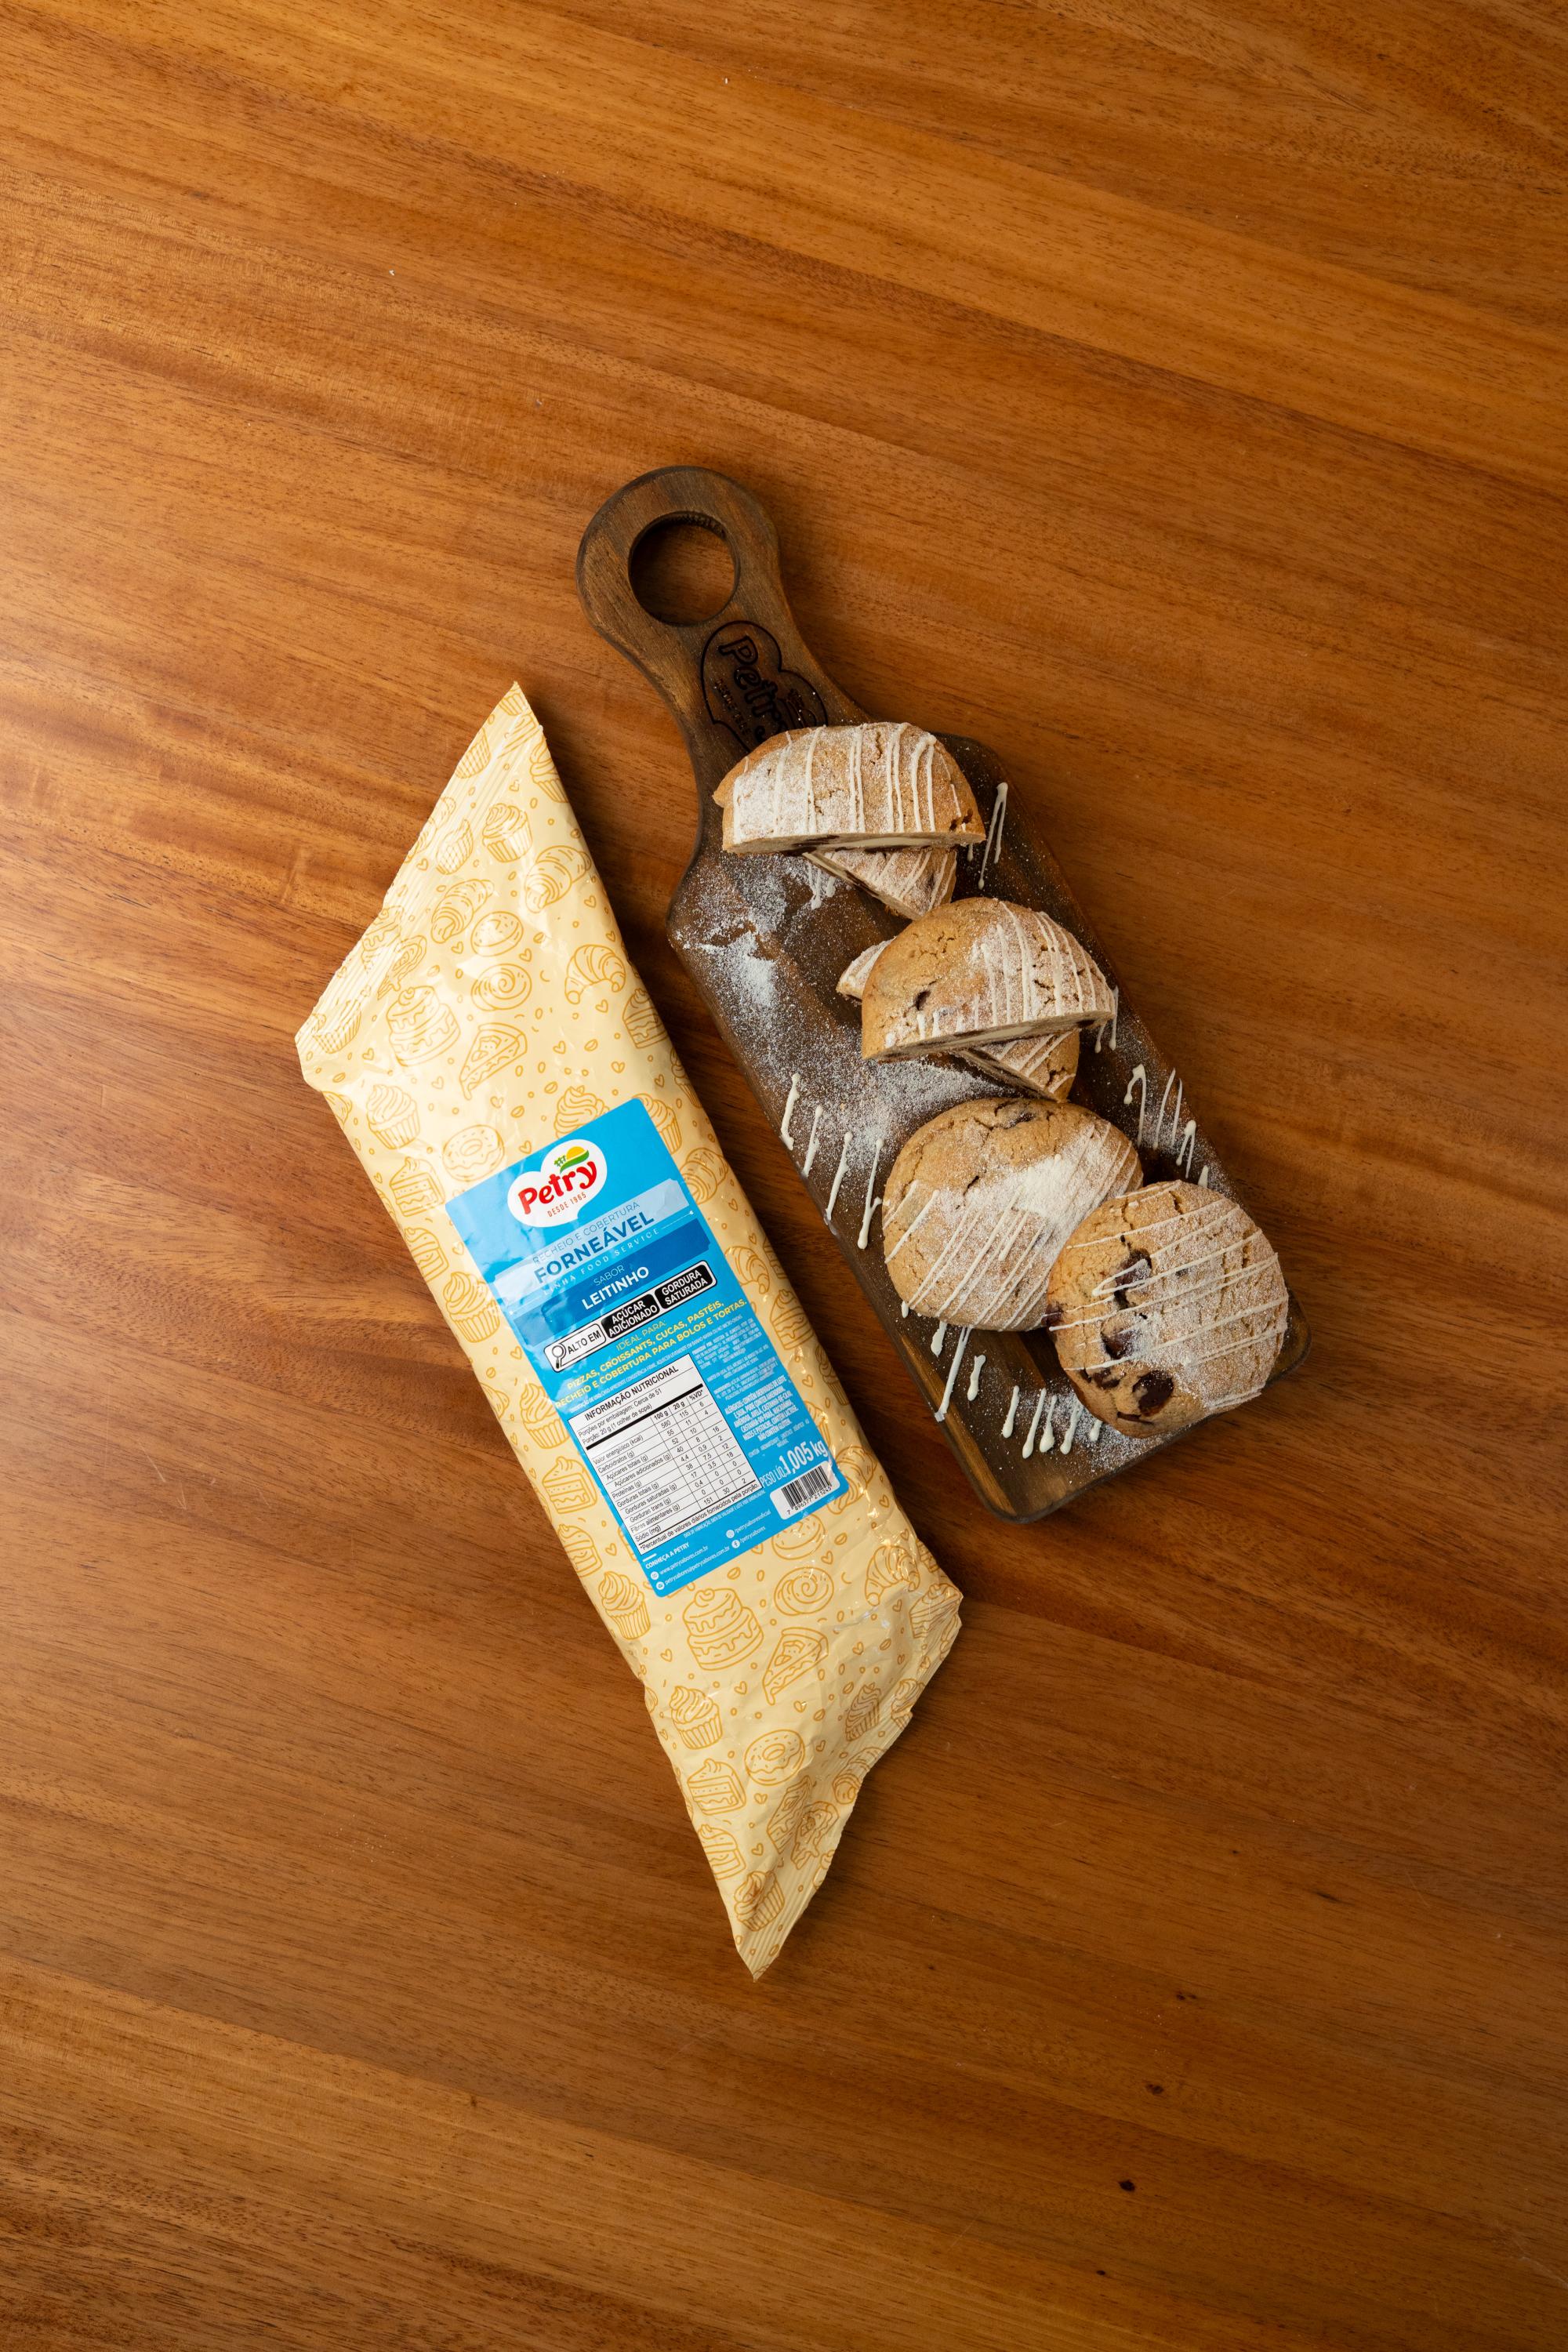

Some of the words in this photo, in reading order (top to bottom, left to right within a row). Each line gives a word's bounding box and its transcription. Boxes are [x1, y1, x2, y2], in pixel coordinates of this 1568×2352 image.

[517, 1160, 597, 1214] Petry
[546, 1201, 568, 1217] DESDE
[570, 1191, 586, 1204] 1965
[532, 1236, 575, 1263] RECHEIO
[583, 1201, 640, 1236] COBERTURA
[535, 1211, 655, 1282] FORNEÁVEL
[542, 1275, 575, 1296] LINHA
[580, 1255, 608, 1274] FOOD
[613, 1228, 659, 1256] SERVICE
[593, 1265, 625, 1286] SABOR
[582, 1266, 648, 1309] LEITINHO
[661, 1269, 702, 1295] GORDURA
[664, 1277, 708, 1305] SATURADA
[608, 1305, 659, 1338] ADICIONADO
[609, 1298, 647, 1326] AÇÚCAR
[565, 1338, 587, 1354] ALTO
[587, 1330, 601, 1342] EM
[566, 1369, 600, 1391] PIZZAS,
[599, 1338, 655, 1372] CROISSANTS,
[655, 1320, 688, 1341] CUCAS,
[687, 1300, 724, 1323] PASTÉIS,
[615, 1334, 641, 1350] IDEAL
[641, 1320, 666, 1336] PARA:
[554, 1385, 591, 1408] RECHEIO
[599, 1352, 652, 1384] COBERTURA
[651, 1338, 676, 1355] PARA
[676, 1321, 706, 1341] BOLOS
[713, 1298, 746, 1319] TORTAS.
[584, 1391, 631, 1421] INFORMAÇÃO
[630, 1365, 678, 1395] NUTRICIONAL
[578, 1425, 597, 1437] Porções
[597, 1419, 605, 1428] por
[605, 1404, 633, 1422] embalagem:
[633, 1396, 648, 1406] Cerca
[582, 1432, 600, 1445] Porção:
[616, 1414, 631, 1425] colher
[637, 1403, 652, 1414] sopa)
[654, 1411, 663, 1420] 100
[593, 1455, 605, 1465] Valor
[605, 1443, 630, 1458] energético
[629, 1434, 643, 1446] (kcal)
[660, 1419, 670, 1428] 580
[597, 1455, 627, 1473] Carboidratos
[606, 1466, 628, 1480] Açúcares
[626, 1458, 641, 1468] totais
[640, 1454, 648, 1462] (g)
[612, 1484, 634, 1499] Proteínas
[698, 1443, 706, 1452] 0,9
[614, 1472, 636, 1487] Açúcares
[635, 1457, 663, 1475] adicionados
[662, 1452, 671, 1461] (g)
[616, 1494, 638, 1507] Gorduras
[637, 1486, 652, 1496] totais
[702, 1452, 711, 1461] 7,5
[758, 1471, 776, 1488] PESO
[779, 1442, 814, 1473] 1,005
[813, 1439, 828, 1457] kg
[625, 1500, 646, 1514] Gorduras
[646, 1487, 670, 1503] saturadas
[630, 1508, 651, 1523] Gorduras
[650, 1501, 663, 1511] trans
[662, 1497, 671, 1505] (g)
[673, 1521, 691, 1532] valores
[690, 1512, 707, 1523] diários
[706, 1498, 731, 1515] fornecidos
[731, 1492, 742, 1502] pela
[741, 1483, 759, 1496] porção.
[793, 1497, 811, 1510] 896577
[630, 1523, 646, 1534] Fibras
[645, 1508, 673, 1525] alimentares
[635, 1532, 649, 1541] Sódio
[648, 1524, 661, 1535] (mg)
[645, 1553, 670, 1569] CONHEÇA
[673, 1542, 689, 1554] PETRY
